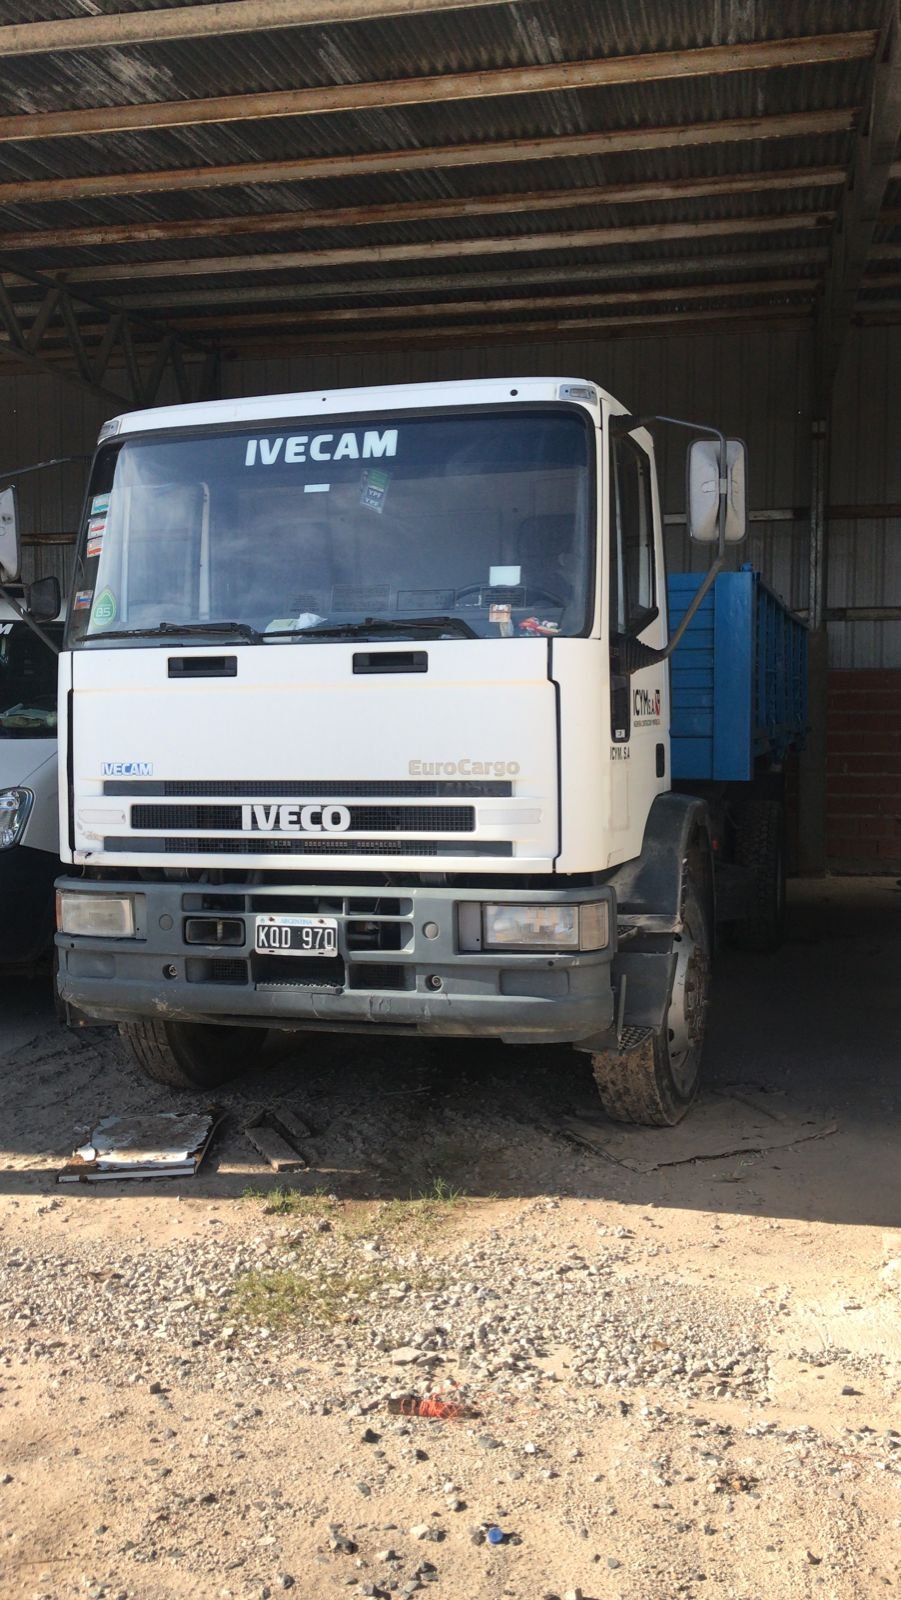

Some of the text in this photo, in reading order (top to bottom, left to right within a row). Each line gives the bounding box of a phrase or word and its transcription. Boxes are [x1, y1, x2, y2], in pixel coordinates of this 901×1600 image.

[245, 429, 398, 467] IVECAM
[101, 762, 153, 776] IVECAM
[408, 759, 521, 777] EuroCargo
[241, 804, 351, 832] IVECO
[302, 928, 334, 949] 970
